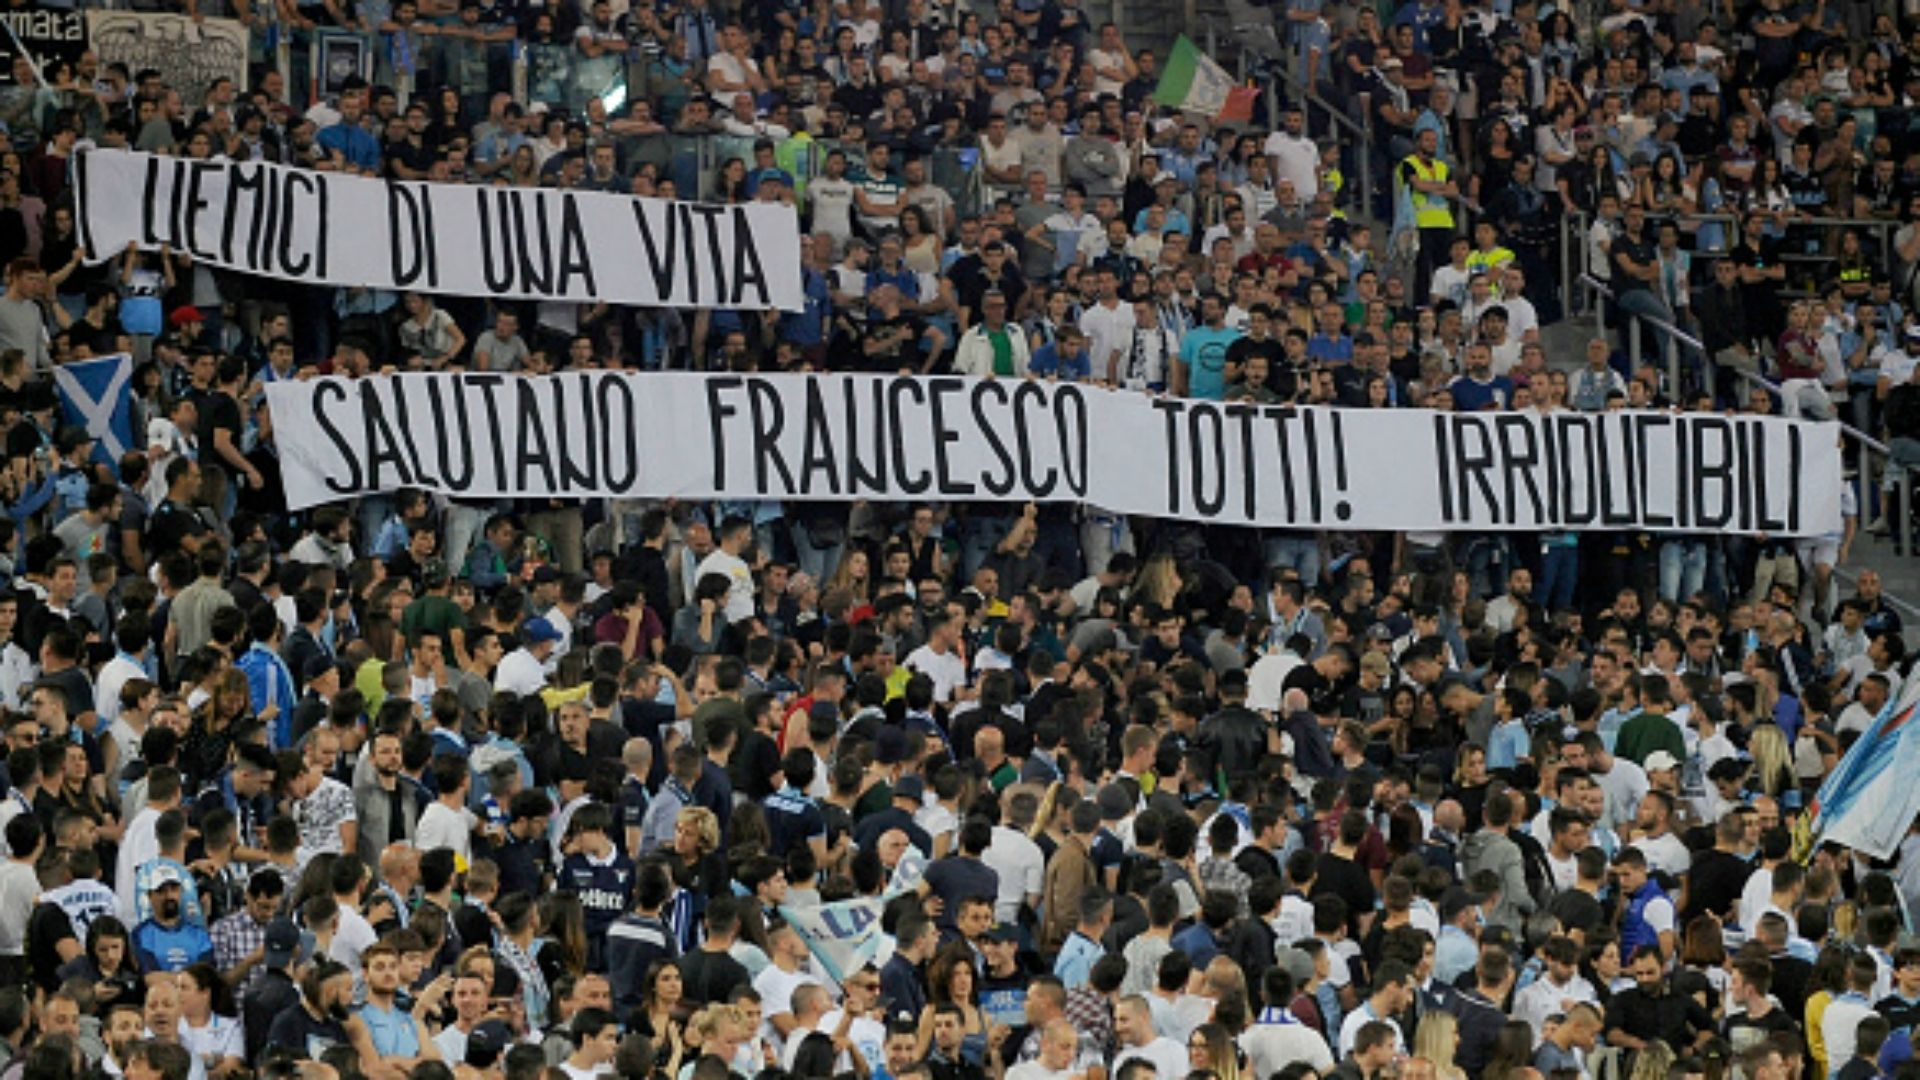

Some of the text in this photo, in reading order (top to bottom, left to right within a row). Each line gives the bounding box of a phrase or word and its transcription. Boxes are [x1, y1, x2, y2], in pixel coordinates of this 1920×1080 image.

[76, 153, 96, 260] I
[388, 178, 438, 288] DI
[477, 188, 597, 297] UNA
[632, 199, 771, 305] VITA
[312, 373, 1802, 532] SALUTANO FRANCESCO TOTTI! IRRIDUCIBILI
